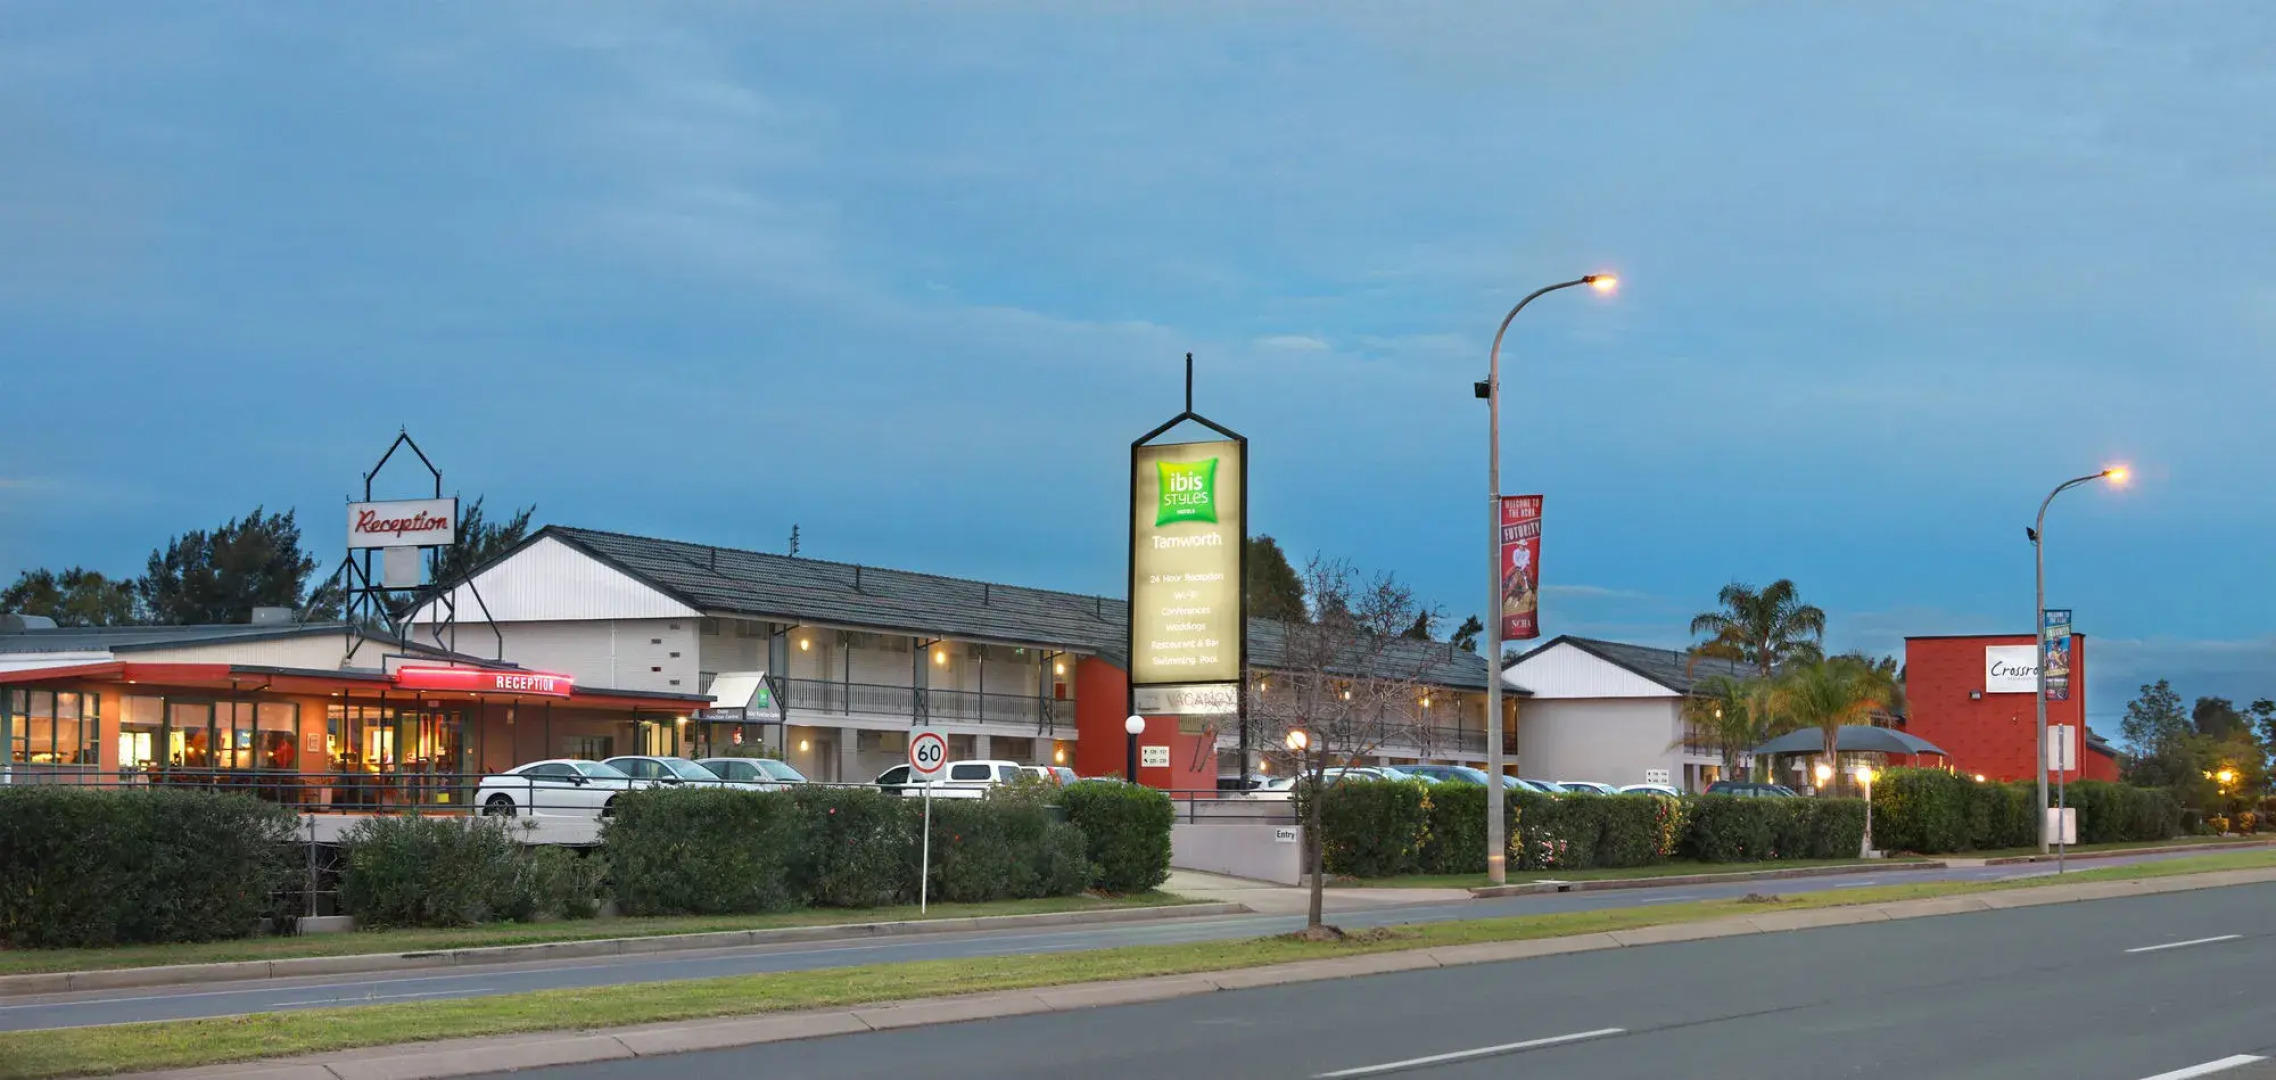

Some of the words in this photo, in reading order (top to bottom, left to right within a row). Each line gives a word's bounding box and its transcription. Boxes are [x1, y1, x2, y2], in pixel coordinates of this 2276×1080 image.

[1170, 470, 1203, 492] ibis
[1508, 508, 1519, 518] THE
[354, 510, 448, 537] Reception
[1504, 521, 1540, 541] FUTURITY
[1152, 531, 1222, 549] Tamworth
[1162, 574, 1182, 583] Hour
[1184, 572, 1224, 582] Reception
[1161, 606, 1211, 616] Conferences
[1165, 622, 1206, 632] Weddings
[1151, 640, 1196, 650] Restaurant
[1205, 638, 1219, 647] Bar
[1152, 656, 1196, 666] Swimming
[1200, 655, 1218, 664] Pool
[1991, 660, 2038, 676] Crossro
[496, 675, 555, 692] RECEPTION
[918, 744, 941, 762] 60
[1277, 830, 1295, 840] Entry
